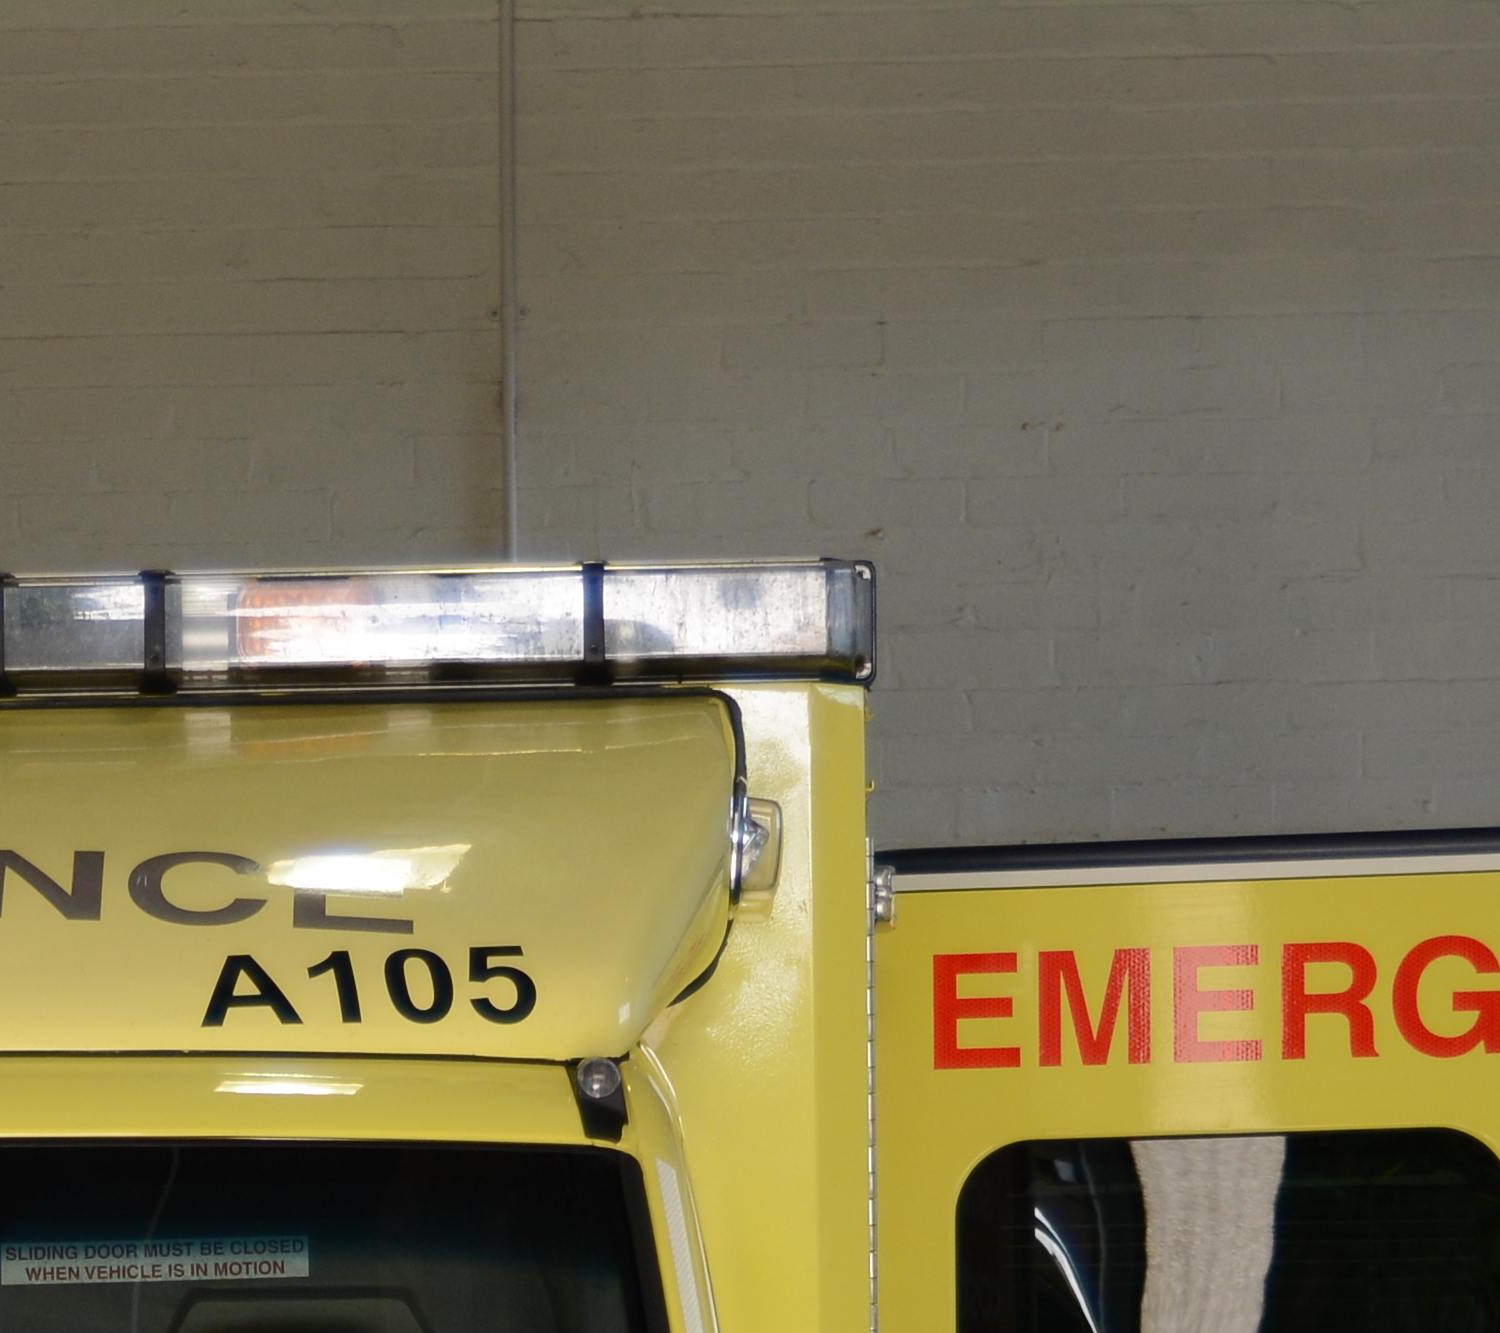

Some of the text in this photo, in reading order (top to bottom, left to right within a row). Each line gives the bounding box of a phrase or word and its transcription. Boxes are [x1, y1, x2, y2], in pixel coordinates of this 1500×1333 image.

[201, 945, 537, 1027] A105
[5, 1239, 305, 1261] SLIDING DOOR MUST BE CLOSED
[25, 1260, 286, 1281] WHEN VEHICLE IS IN MOTION
